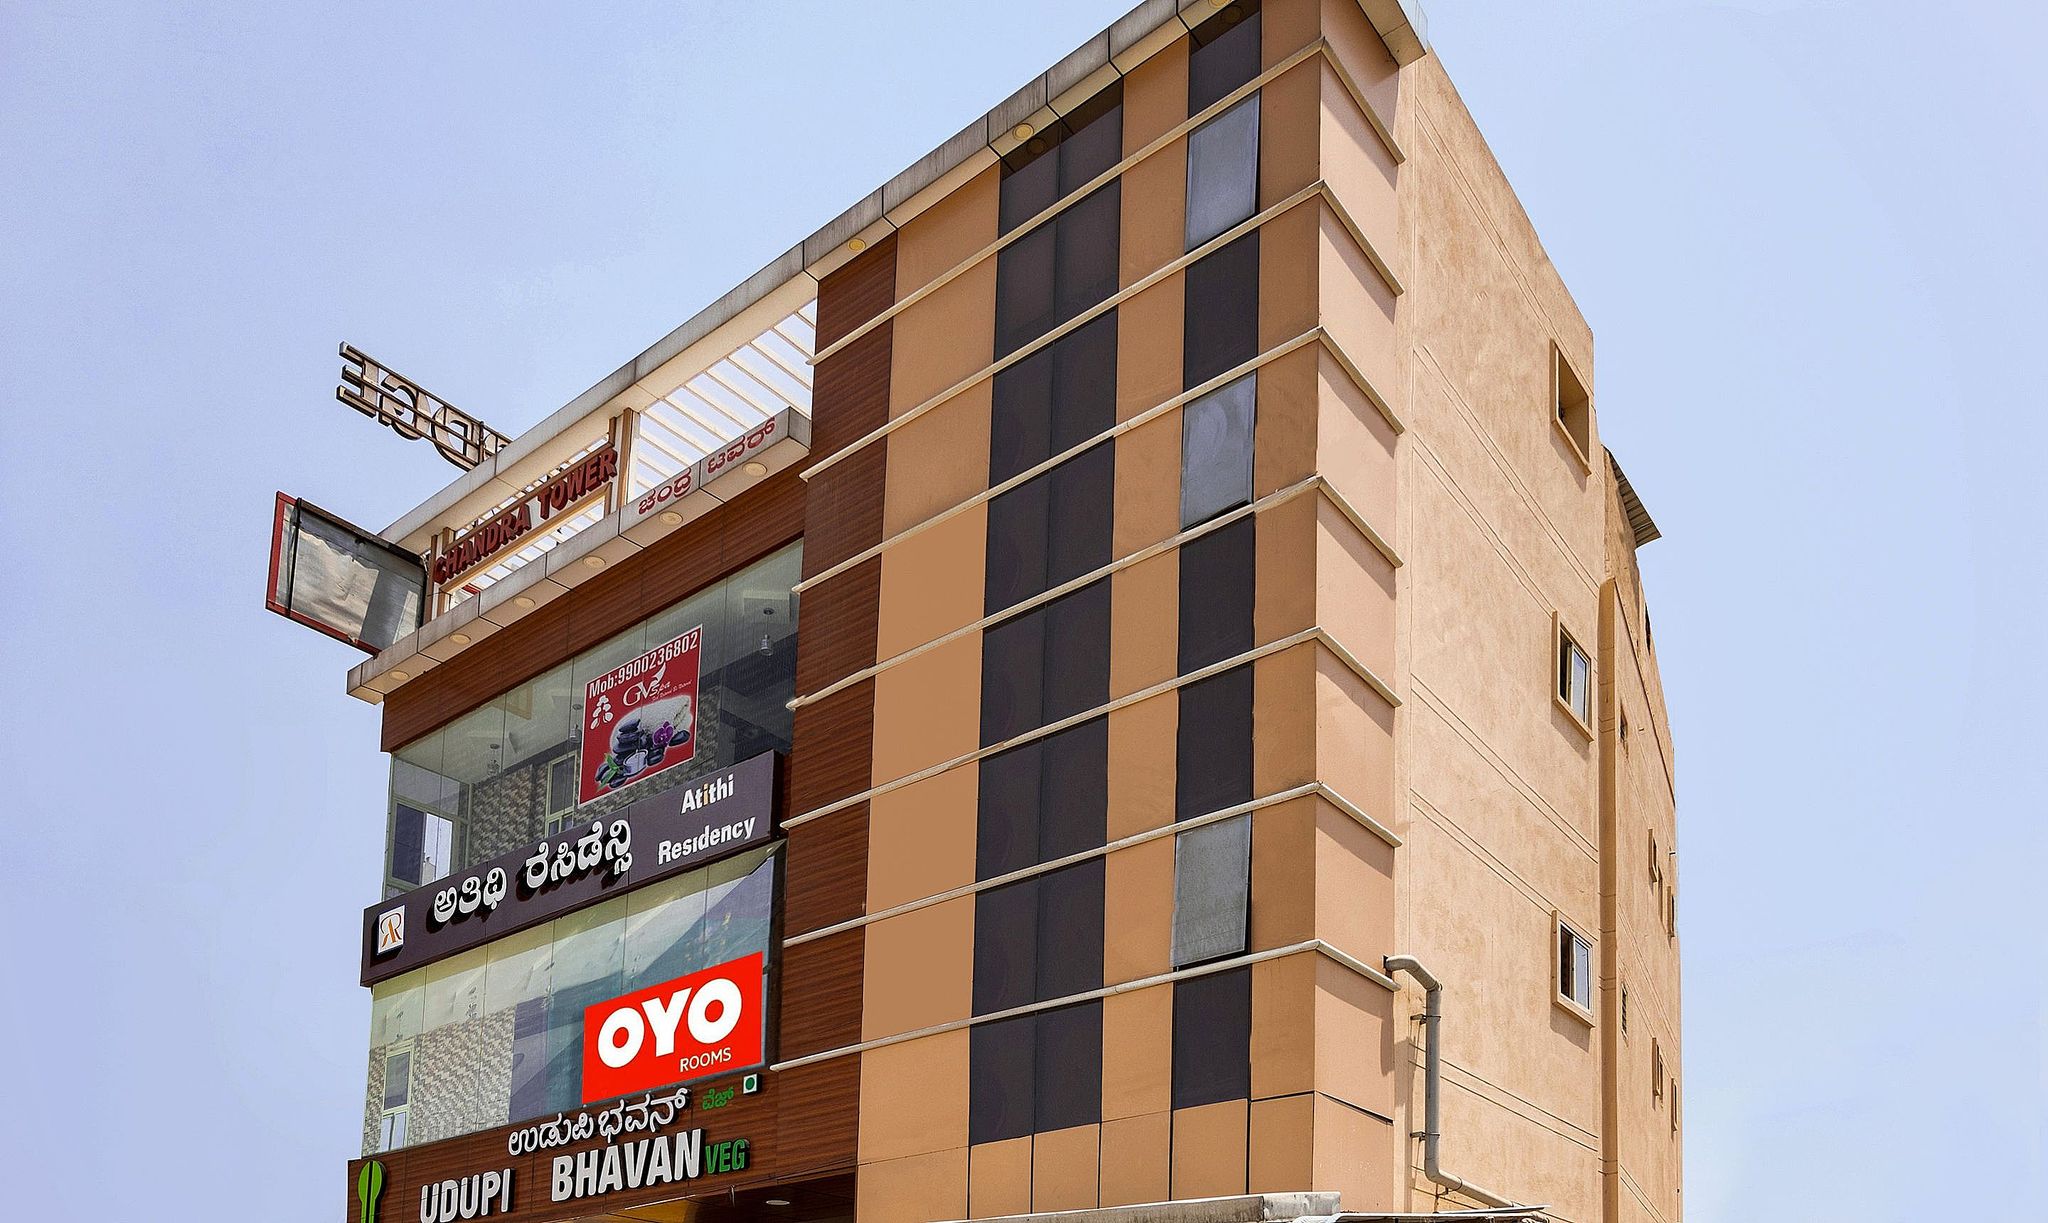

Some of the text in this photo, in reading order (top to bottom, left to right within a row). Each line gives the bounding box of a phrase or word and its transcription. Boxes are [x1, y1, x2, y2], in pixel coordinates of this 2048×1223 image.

[638, 416, 776, 515] ಚಂದ್ರ ಟವರ್
[433, 447, 618, 585] CHANDRA TOWER
[589, 631, 698, 699] Mob:9900236802
[680, 773, 734, 814] Atithi
[525, 819, 633, 889] ರೆಸಿಡೆನ್ಸಿ
[658, 816, 756, 866] Residency
[597, 978, 743, 1069] OYO
[679, 1047, 733, 1073] ROOMS
[508, 1112, 594, 1156] ಉಡುಪಿ
[598, 1087, 688, 1144] ಭವನ್
[420, 1128, 746, 1223] UDUPI BHAVAN VEG
